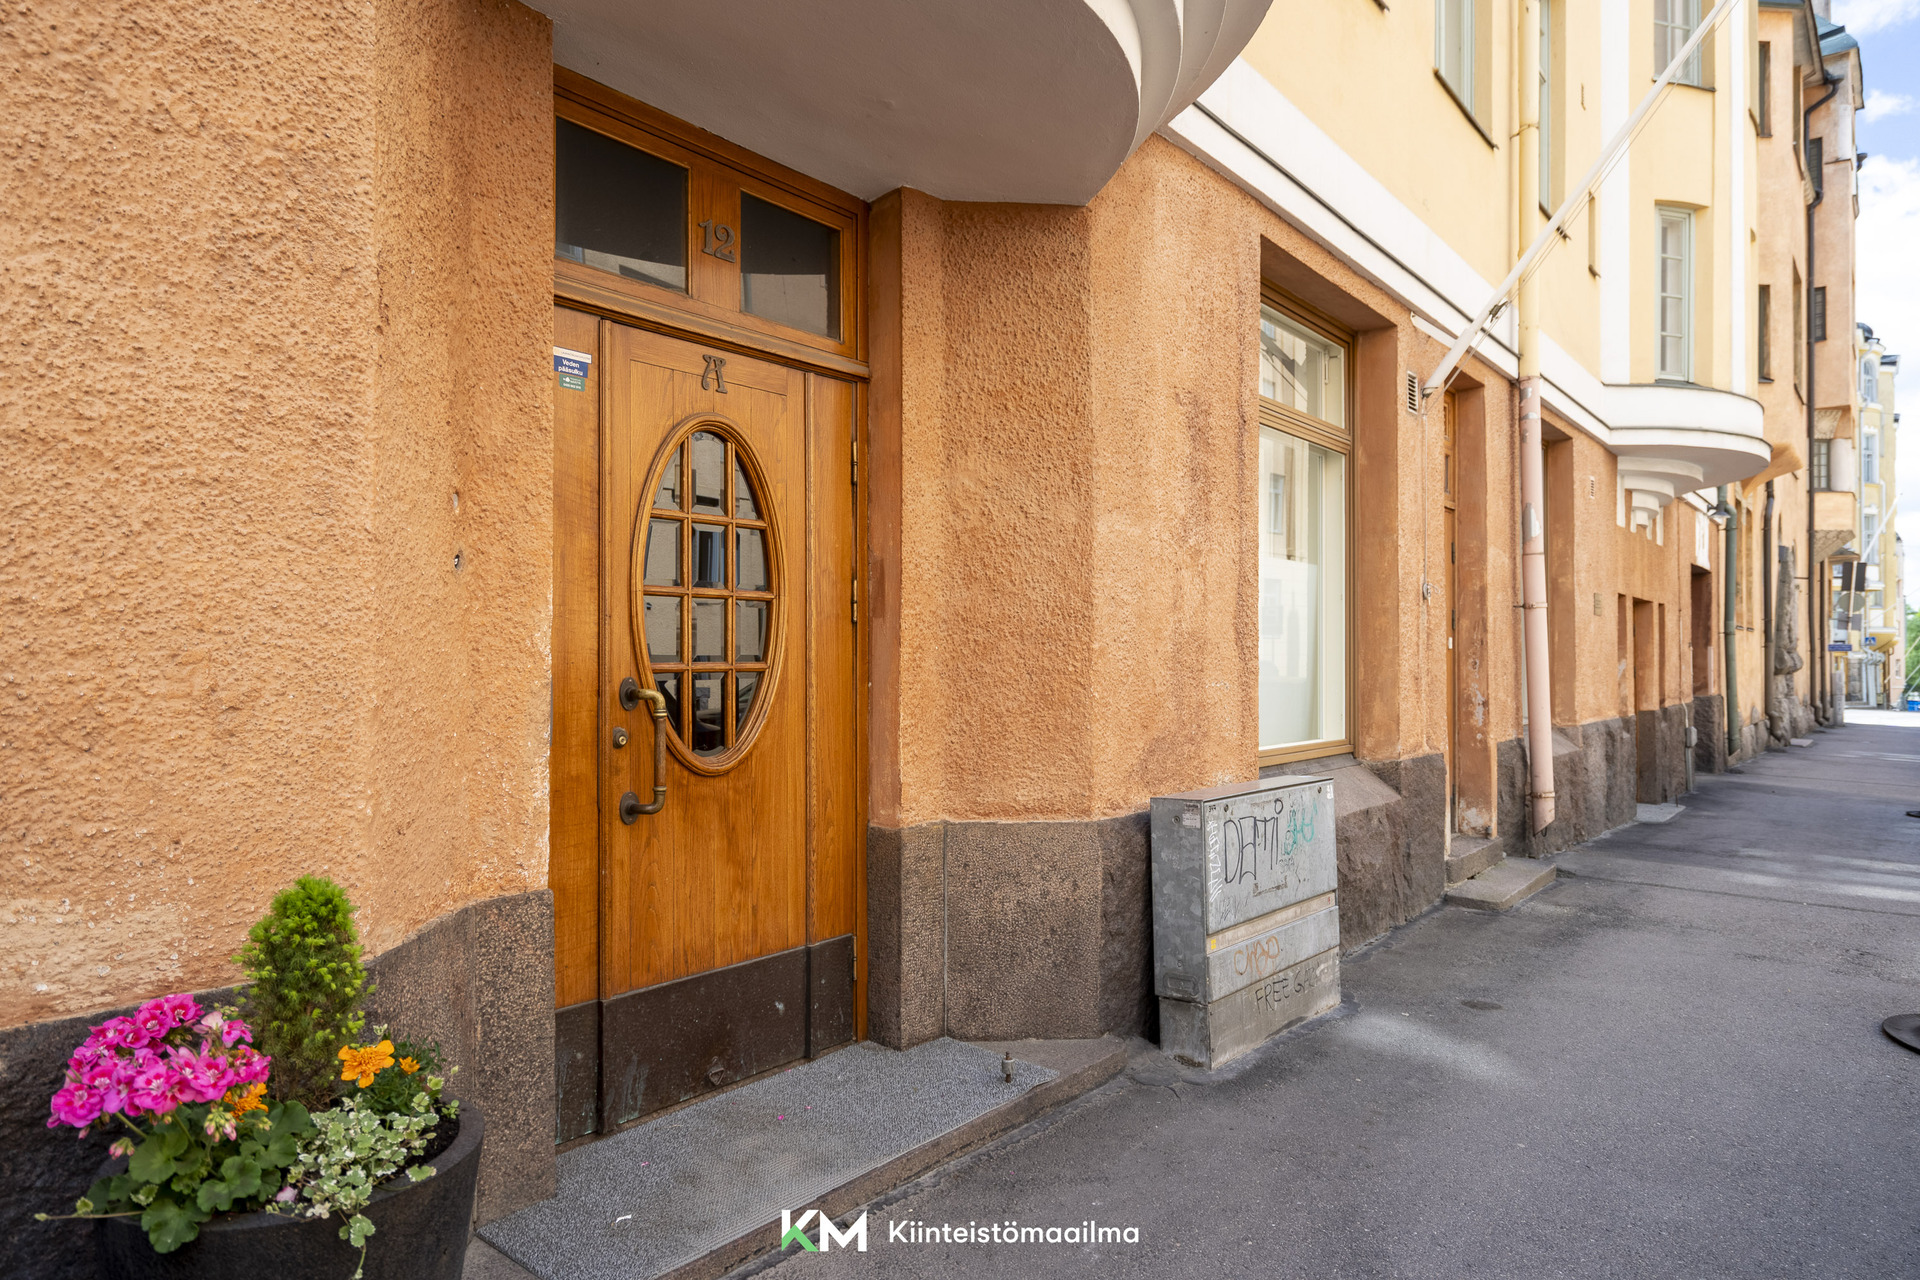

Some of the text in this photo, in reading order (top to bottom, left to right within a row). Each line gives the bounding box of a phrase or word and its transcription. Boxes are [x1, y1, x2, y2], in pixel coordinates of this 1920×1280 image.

[698, 218, 736, 264] 12
[562, 358, 580, 369] Veden
[702, 354, 728, 394] A
[1254, 978, 1290, 1015] FREE
